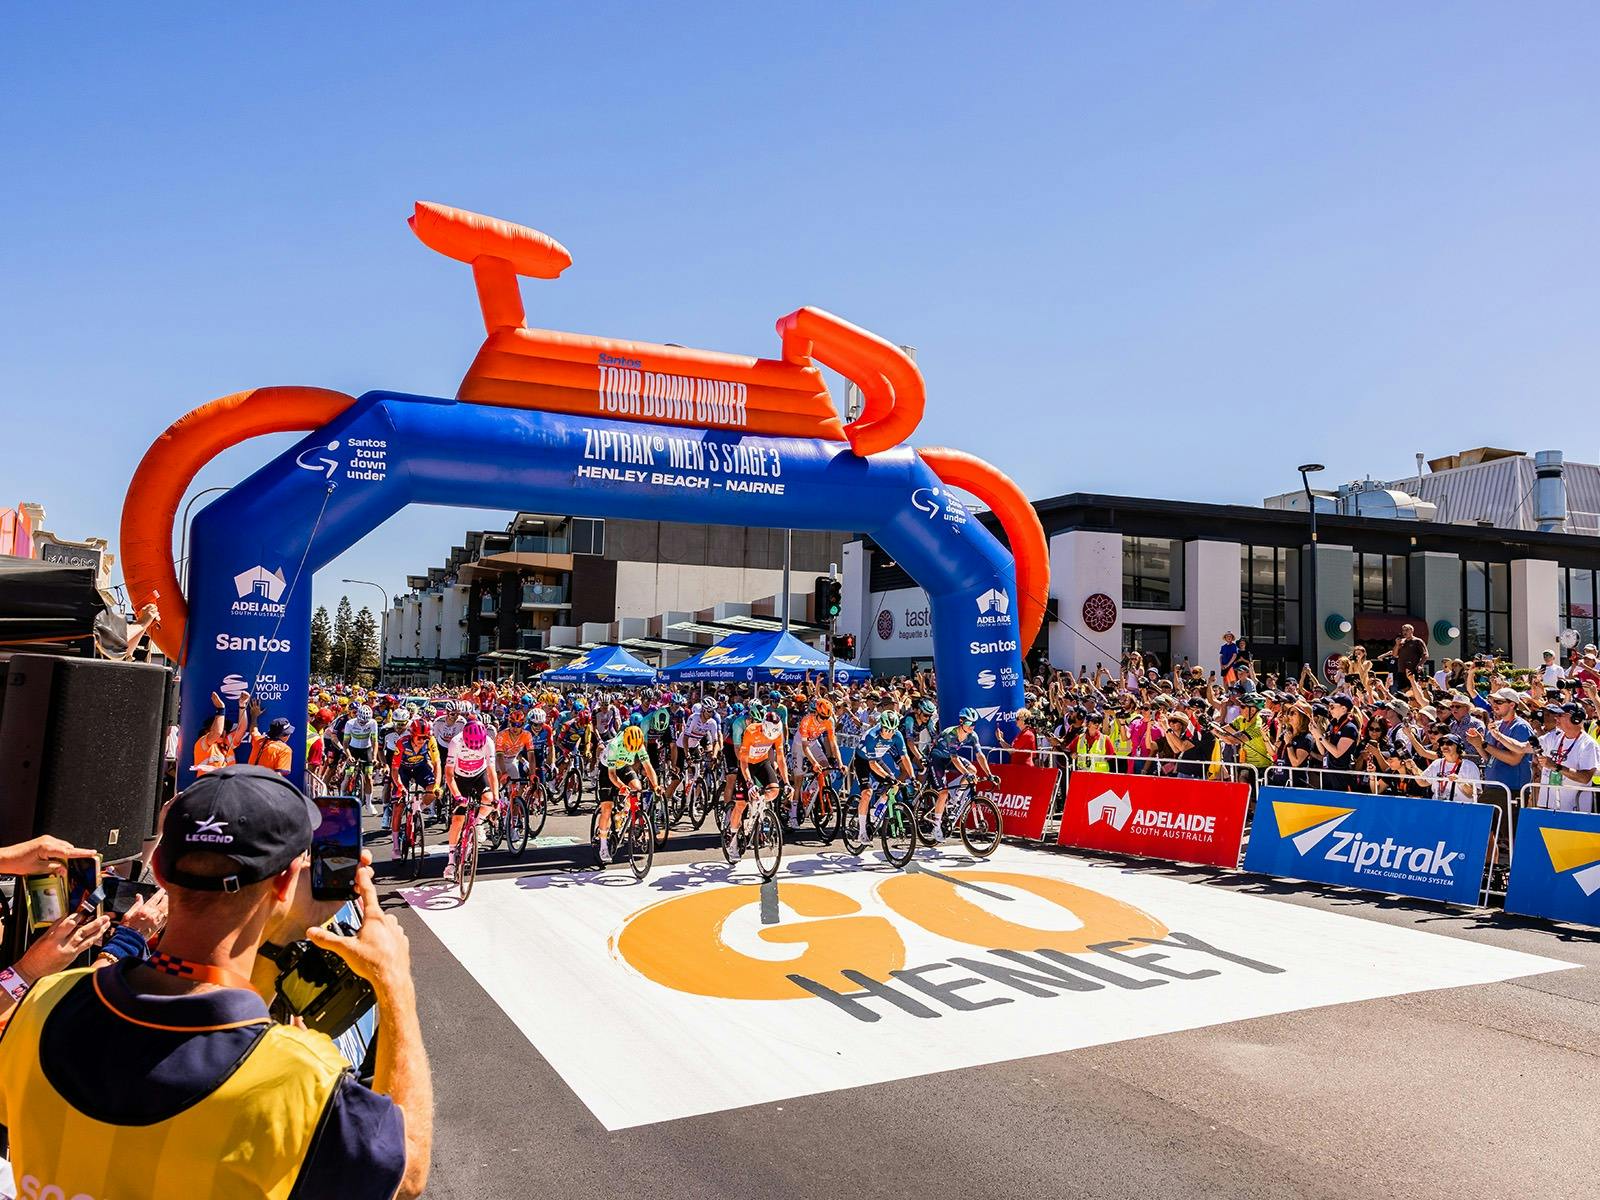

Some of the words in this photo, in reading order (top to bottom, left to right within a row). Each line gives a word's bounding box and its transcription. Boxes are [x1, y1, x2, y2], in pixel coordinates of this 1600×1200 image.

[598, 353, 642, 368] Santos
[598, 365, 642, 415] TOUR
[643, 371, 695, 421] DOWN
[696, 378, 748, 426] UNDER
[348, 438, 387, 448] Santos
[356, 448, 387, 459] tour
[350, 457, 386, 470] down
[723, 443, 768, 477] STAGE
[771, 449, 781, 478] 3
[346, 469, 386, 481] under
[577, 465, 648, 483] HENLEY
[651, 472, 710, 489] BEACH
[725, 479, 786, 495] NAIRNE
[943, 513, 967, 525] under
[231, 601, 286, 613] ADELAIDE
[905, 607, 933, 627] tast
[976, 615, 1012, 624] ADELAIDE
[215, 633, 291, 653] Santos
[970, 640, 1017, 655] Santos
[256, 674, 277, 683] UCI
[780, 673, 802, 681] Ziptrak
[255, 683, 290, 692] WORLD
[256, 691, 282, 700] TOUR
[995, 710, 1018, 723] Ziptr
[1131, 808, 1216, 834] ADELAIDE
[185, 833, 234, 844] LEGEND
[1129, 825, 1160, 837] SOUTH
[1162, 830, 1213, 843] AUSTRALIA
[1363, 868, 1382, 877] TRACK
[1383, 871, 1407, 880] GUIDED
[1407, 874, 1428, 883] BLIND
[1428, 877, 1455, 887] SYSTEM
[608, 871, 1170, 1001] GO
[786, 932, 1287, 1023] HENLEY
